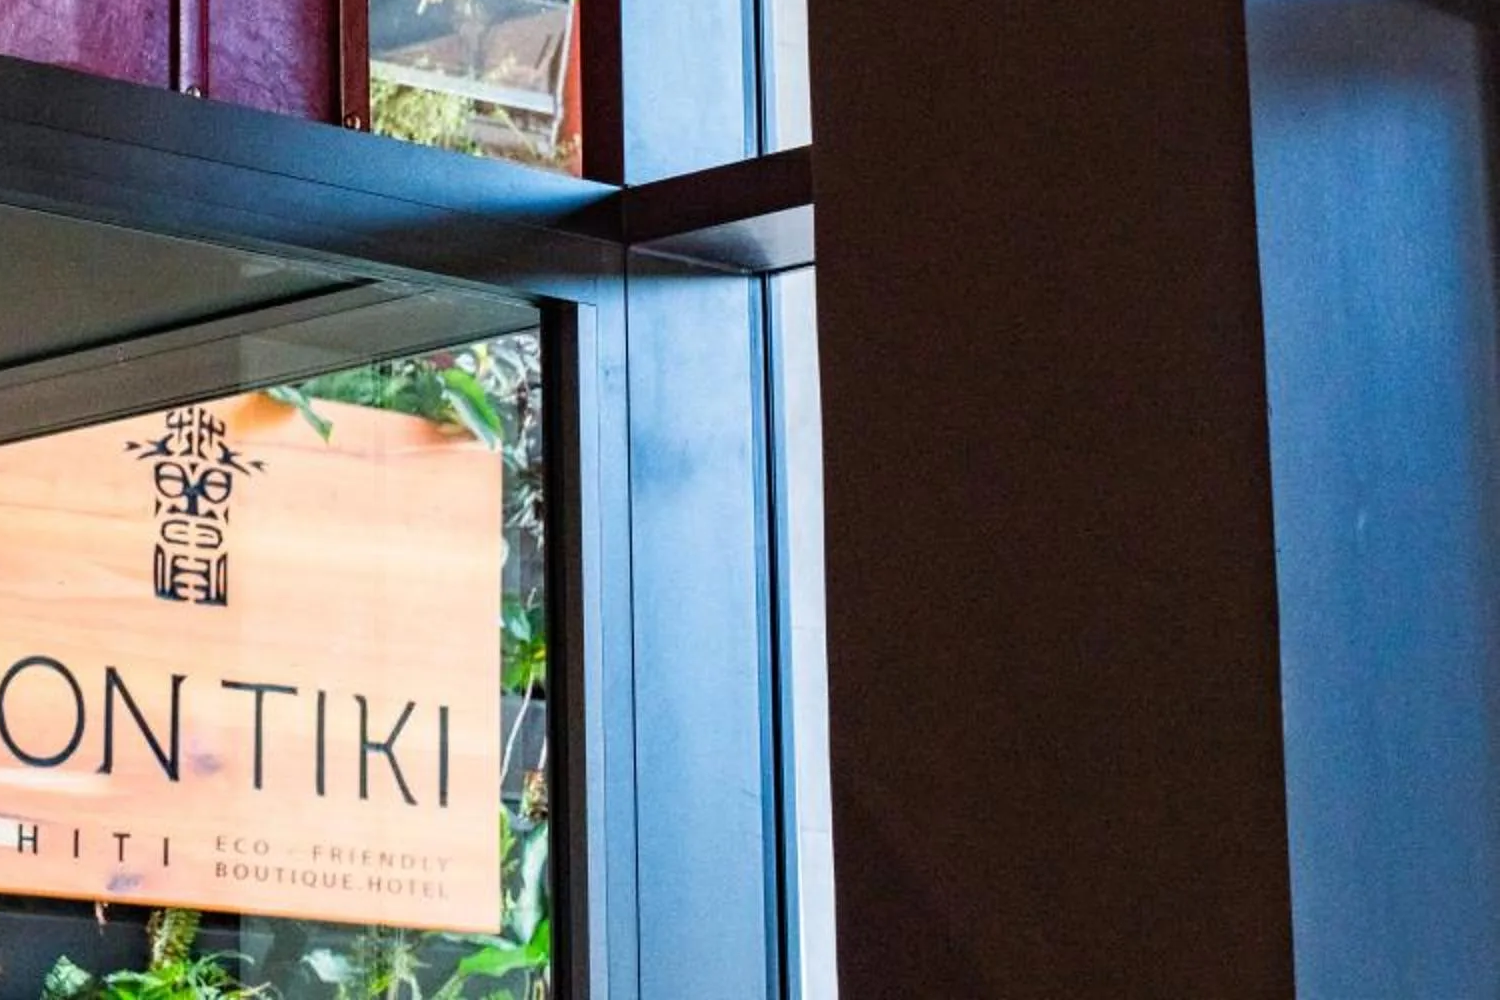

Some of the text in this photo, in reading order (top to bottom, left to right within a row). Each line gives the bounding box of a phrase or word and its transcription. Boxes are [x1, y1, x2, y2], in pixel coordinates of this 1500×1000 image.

[220, 679, 449, 808] TIKI
[311, 844, 451, 874] FRIENDLY
[214, 861, 451, 900] BOUTIQUE HOTEL
